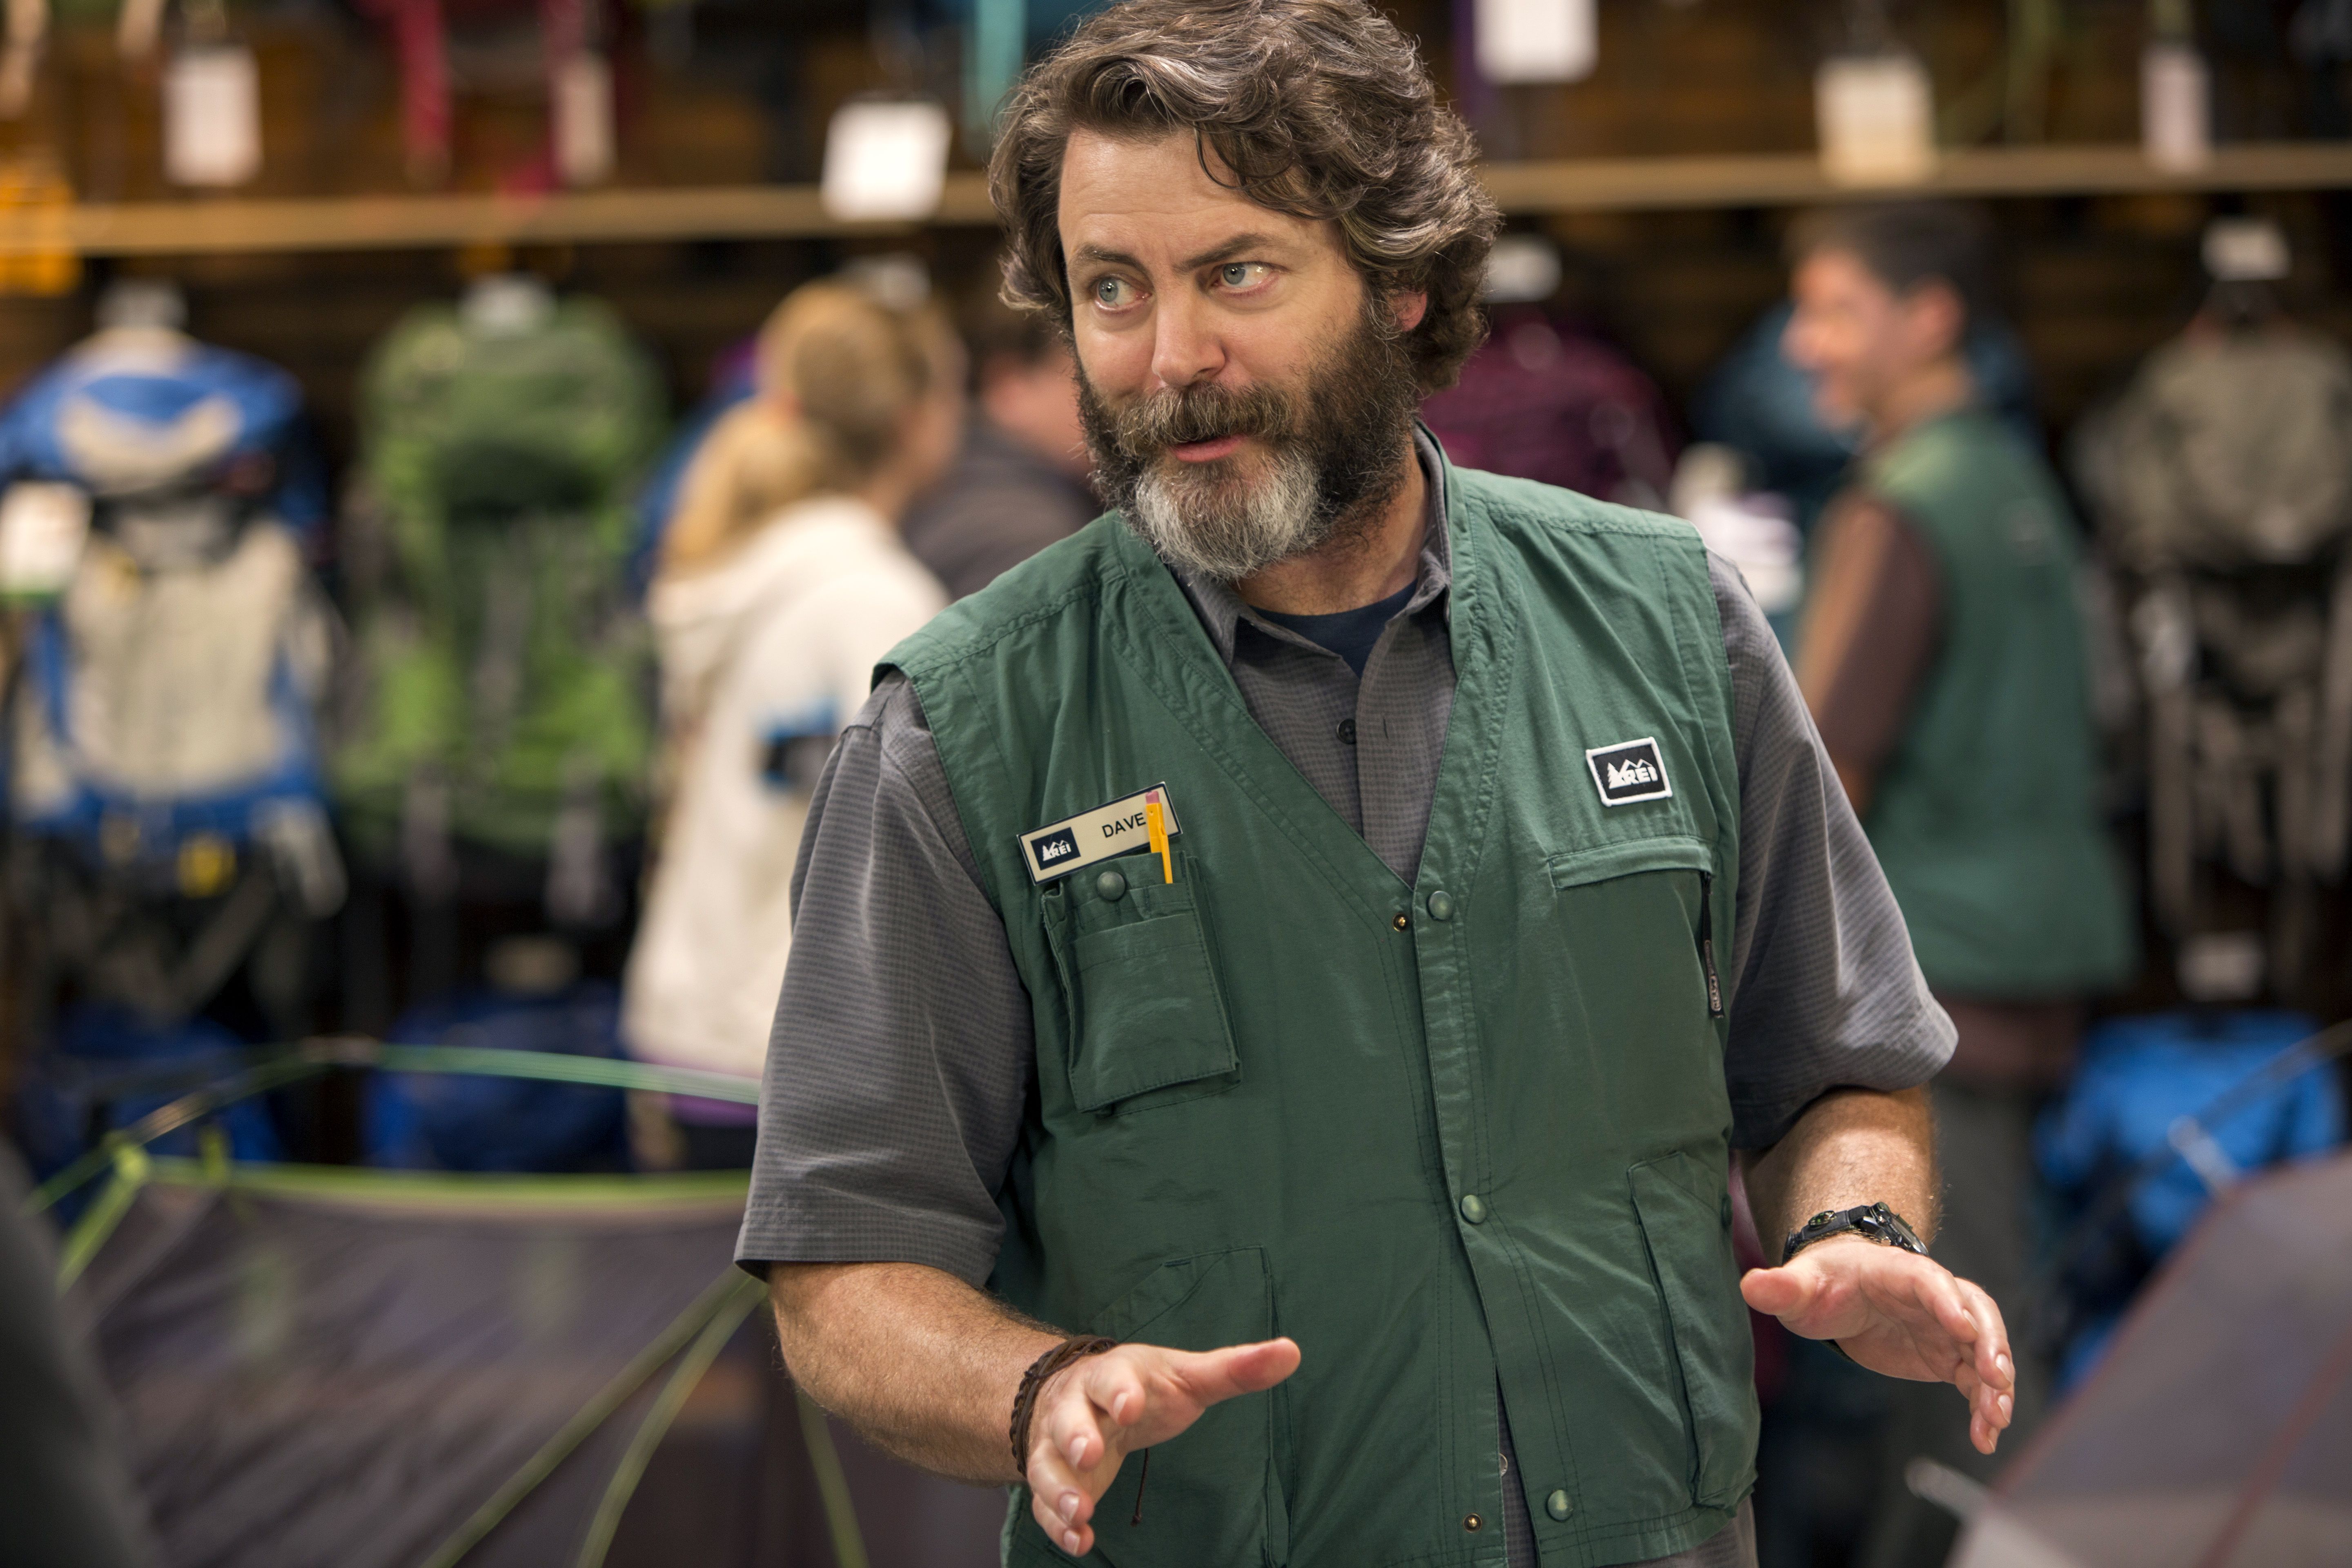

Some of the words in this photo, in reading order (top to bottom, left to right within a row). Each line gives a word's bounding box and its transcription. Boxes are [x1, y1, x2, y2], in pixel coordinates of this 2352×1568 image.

[1623, 766, 1658, 784] REI
[1102, 812, 1146, 838] DAVE
[1050, 843, 1071, 858] REI
